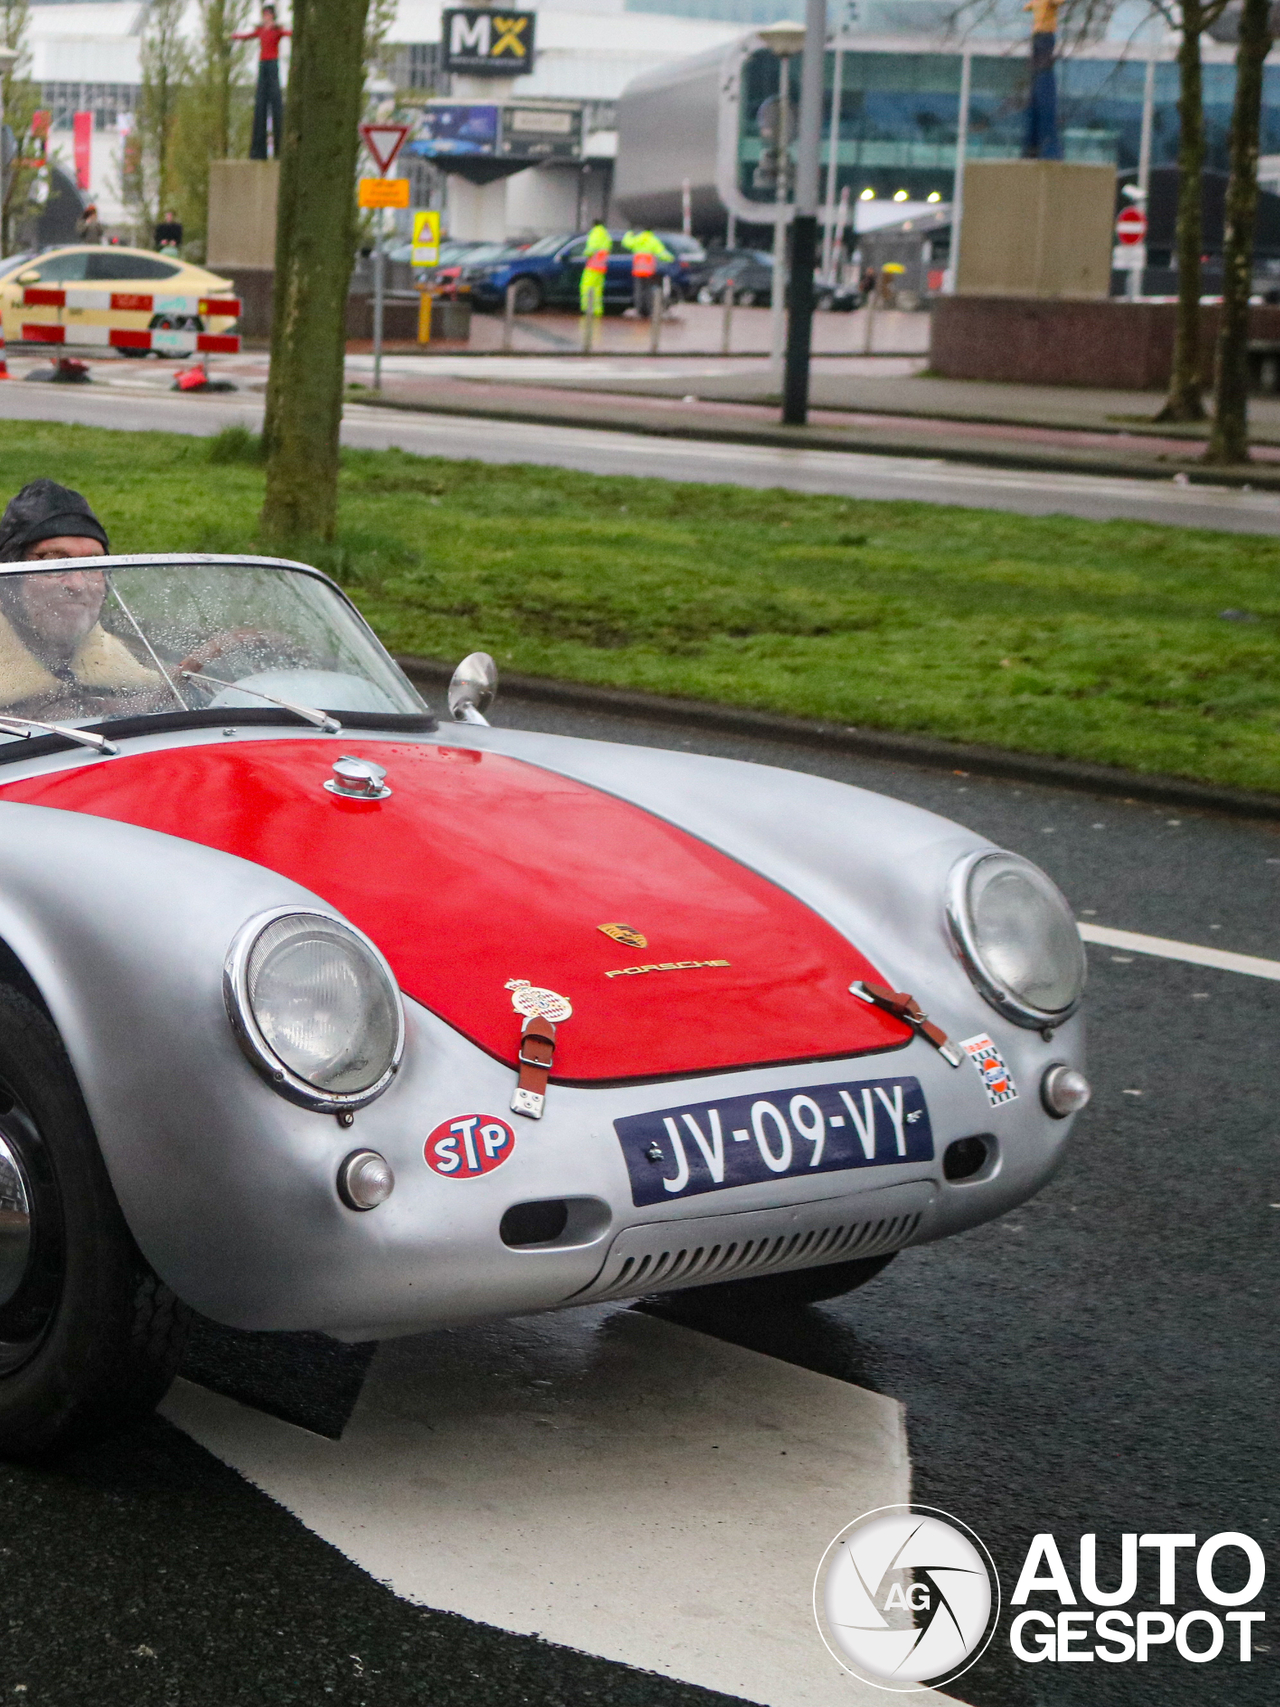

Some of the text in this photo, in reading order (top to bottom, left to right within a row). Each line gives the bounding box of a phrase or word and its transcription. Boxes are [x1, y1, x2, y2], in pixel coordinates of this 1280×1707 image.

[450, 13, 527, 57] MX
[604, 959, 731, 978] PORSCHE
[434, 1116, 508, 1174] STP
[663, 1086, 907, 1192] JV-09-VY
